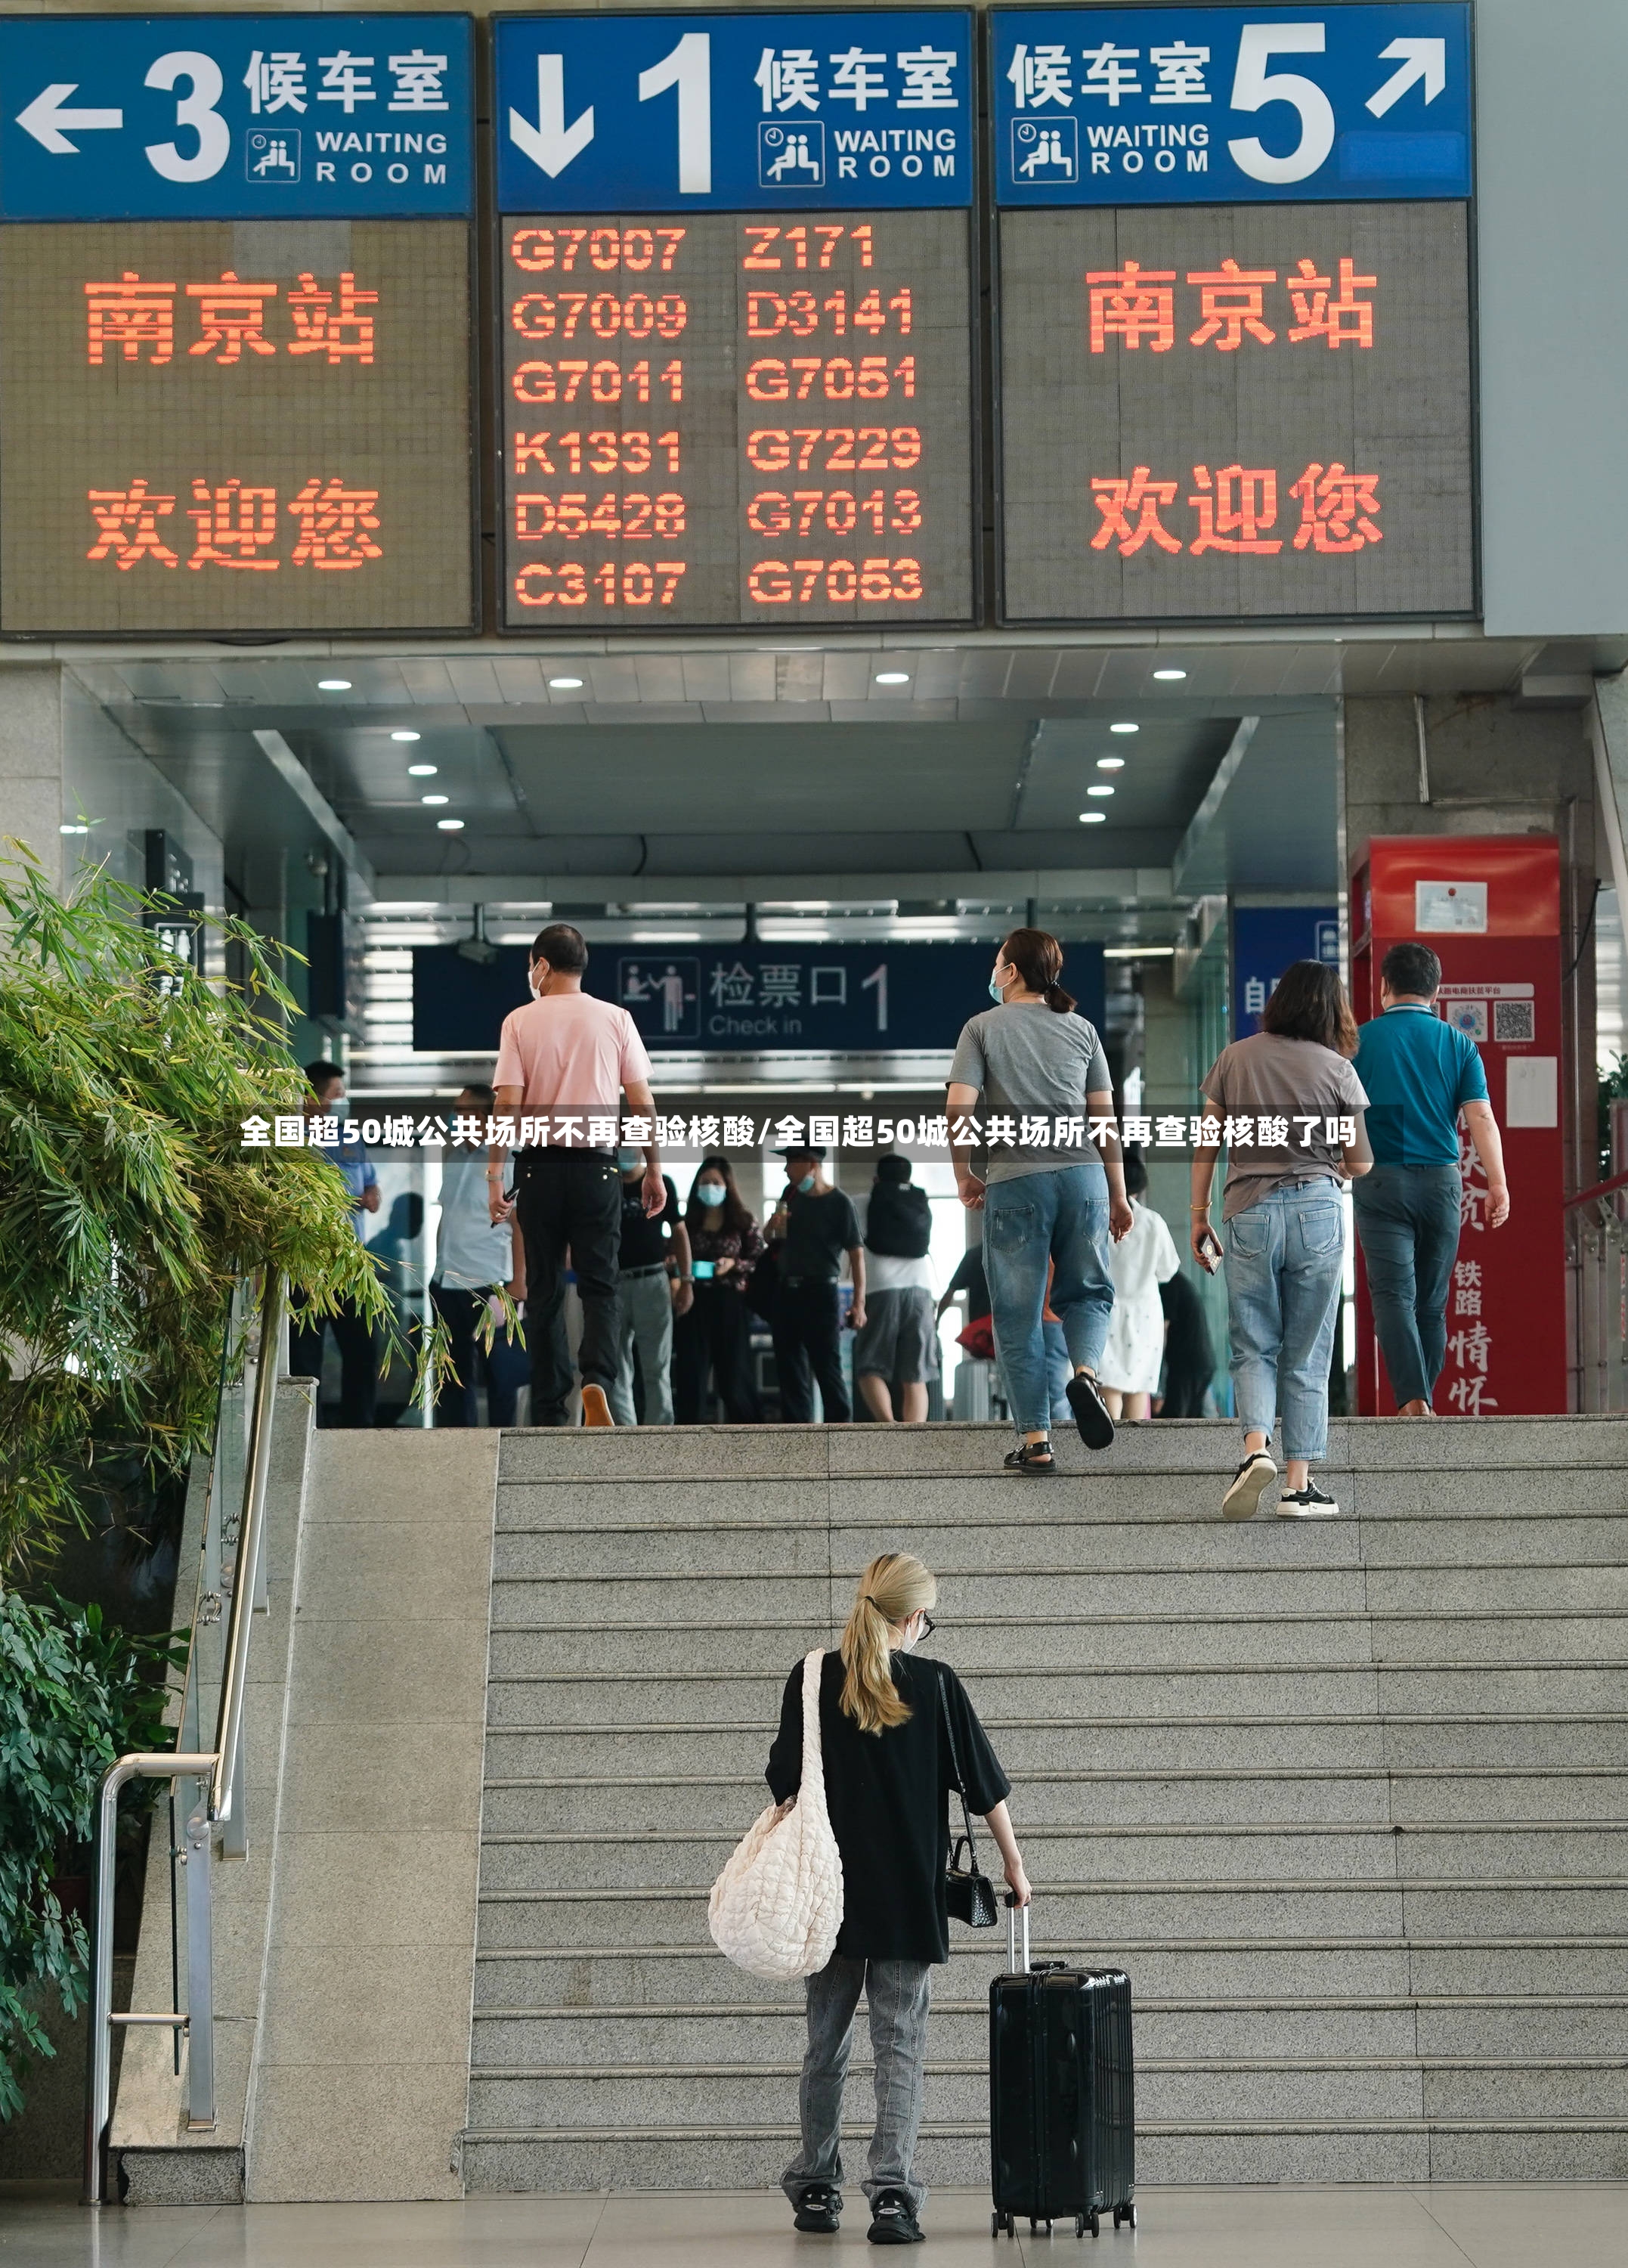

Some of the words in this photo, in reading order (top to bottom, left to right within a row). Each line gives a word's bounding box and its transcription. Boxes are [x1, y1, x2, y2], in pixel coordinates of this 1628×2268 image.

[243, 49, 449, 113] 候车室
[754, 45, 958, 112] 候车室
[1007, 41, 1212, 108] 候车室
[145, 51, 229, 182] 3
[639, 33, 710, 193] 1
[1228, 23, 1335, 184] 5
[317, 132, 447, 153] WAITING
[834, 129, 956, 151] WAITING
[1087, 124, 1209, 147] WAITING
[317, 163, 446, 184] ROOM
[839, 156, 955, 178] ROOM
[1091, 150, 1208, 173] ROOM
[511, 228, 686, 271] G7007
[743, 225, 873, 269] Z171
[85, 271, 379, 364] 南京站
[512, 293, 687, 339] G7009
[747, 288, 911, 337] D3141
[1086, 258, 1378, 353] 南京站
[512, 359, 682, 402] G7011
[745, 356, 915, 400] G7051
[515, 431, 679, 474] K1331
[747, 427, 921, 471] G7229
[86, 478, 383, 571] 欢迎您
[515, 492, 686, 540] D5428
[747, 489, 922, 536] G7013
[1091, 462, 1384, 556] 欢迎您
[515, 562, 686, 606] C3107
[748, 558, 923, 603] G7053
[710, 962, 845, 1008] 检票口
[861, 964, 887, 1031] 1
[1245, 975, 1281, 1015] 自
[709, 1015, 778, 1035] Check
[783, 1015, 803, 1034] in
[1448, 1259, 1499, 1415] 铁路情怀
